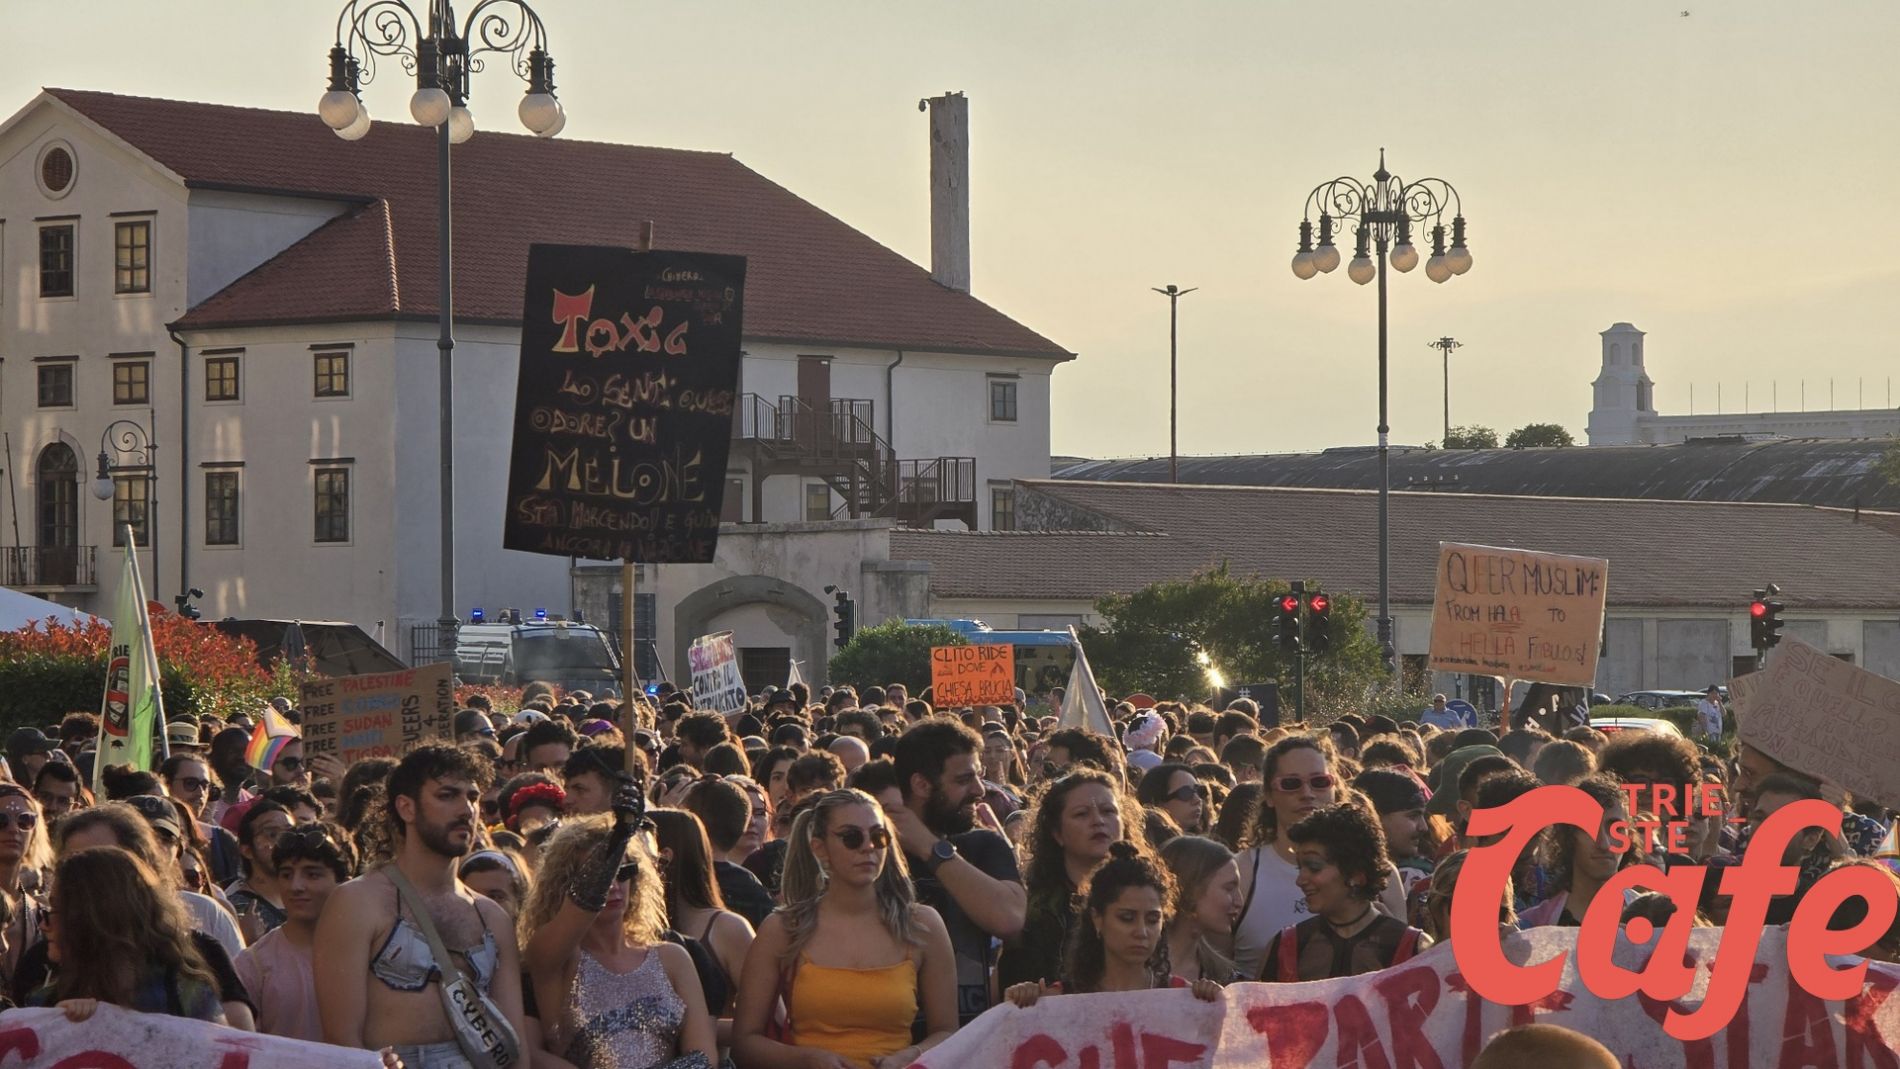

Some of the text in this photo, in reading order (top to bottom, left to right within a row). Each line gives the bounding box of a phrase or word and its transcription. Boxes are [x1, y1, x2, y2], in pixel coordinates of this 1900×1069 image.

[1447, 552, 1517, 596] QUEER
[1446, 600, 1481, 623] FROM
[1547, 607, 1566, 622] TO
[112, 645, 129, 657] RIE
[934, 646, 1007, 662] CLITO RIDE
[1460, 632, 1515, 656] HELLA
[958, 662, 986, 674] DOVE
[1787, 641, 1834, 685] SE
[302, 670, 417, 700] FREE PALESTINE
[723, 664, 733, 687] IL
[937, 679, 1013, 697] CHIESA BRUCIA
[304, 703, 335, 720] FREE
[437, 679, 451, 738] BERATION
[305, 713, 393, 737] FREE SUDAN
[423, 714, 437, 727] 4
[305, 737, 336, 753] FREE
